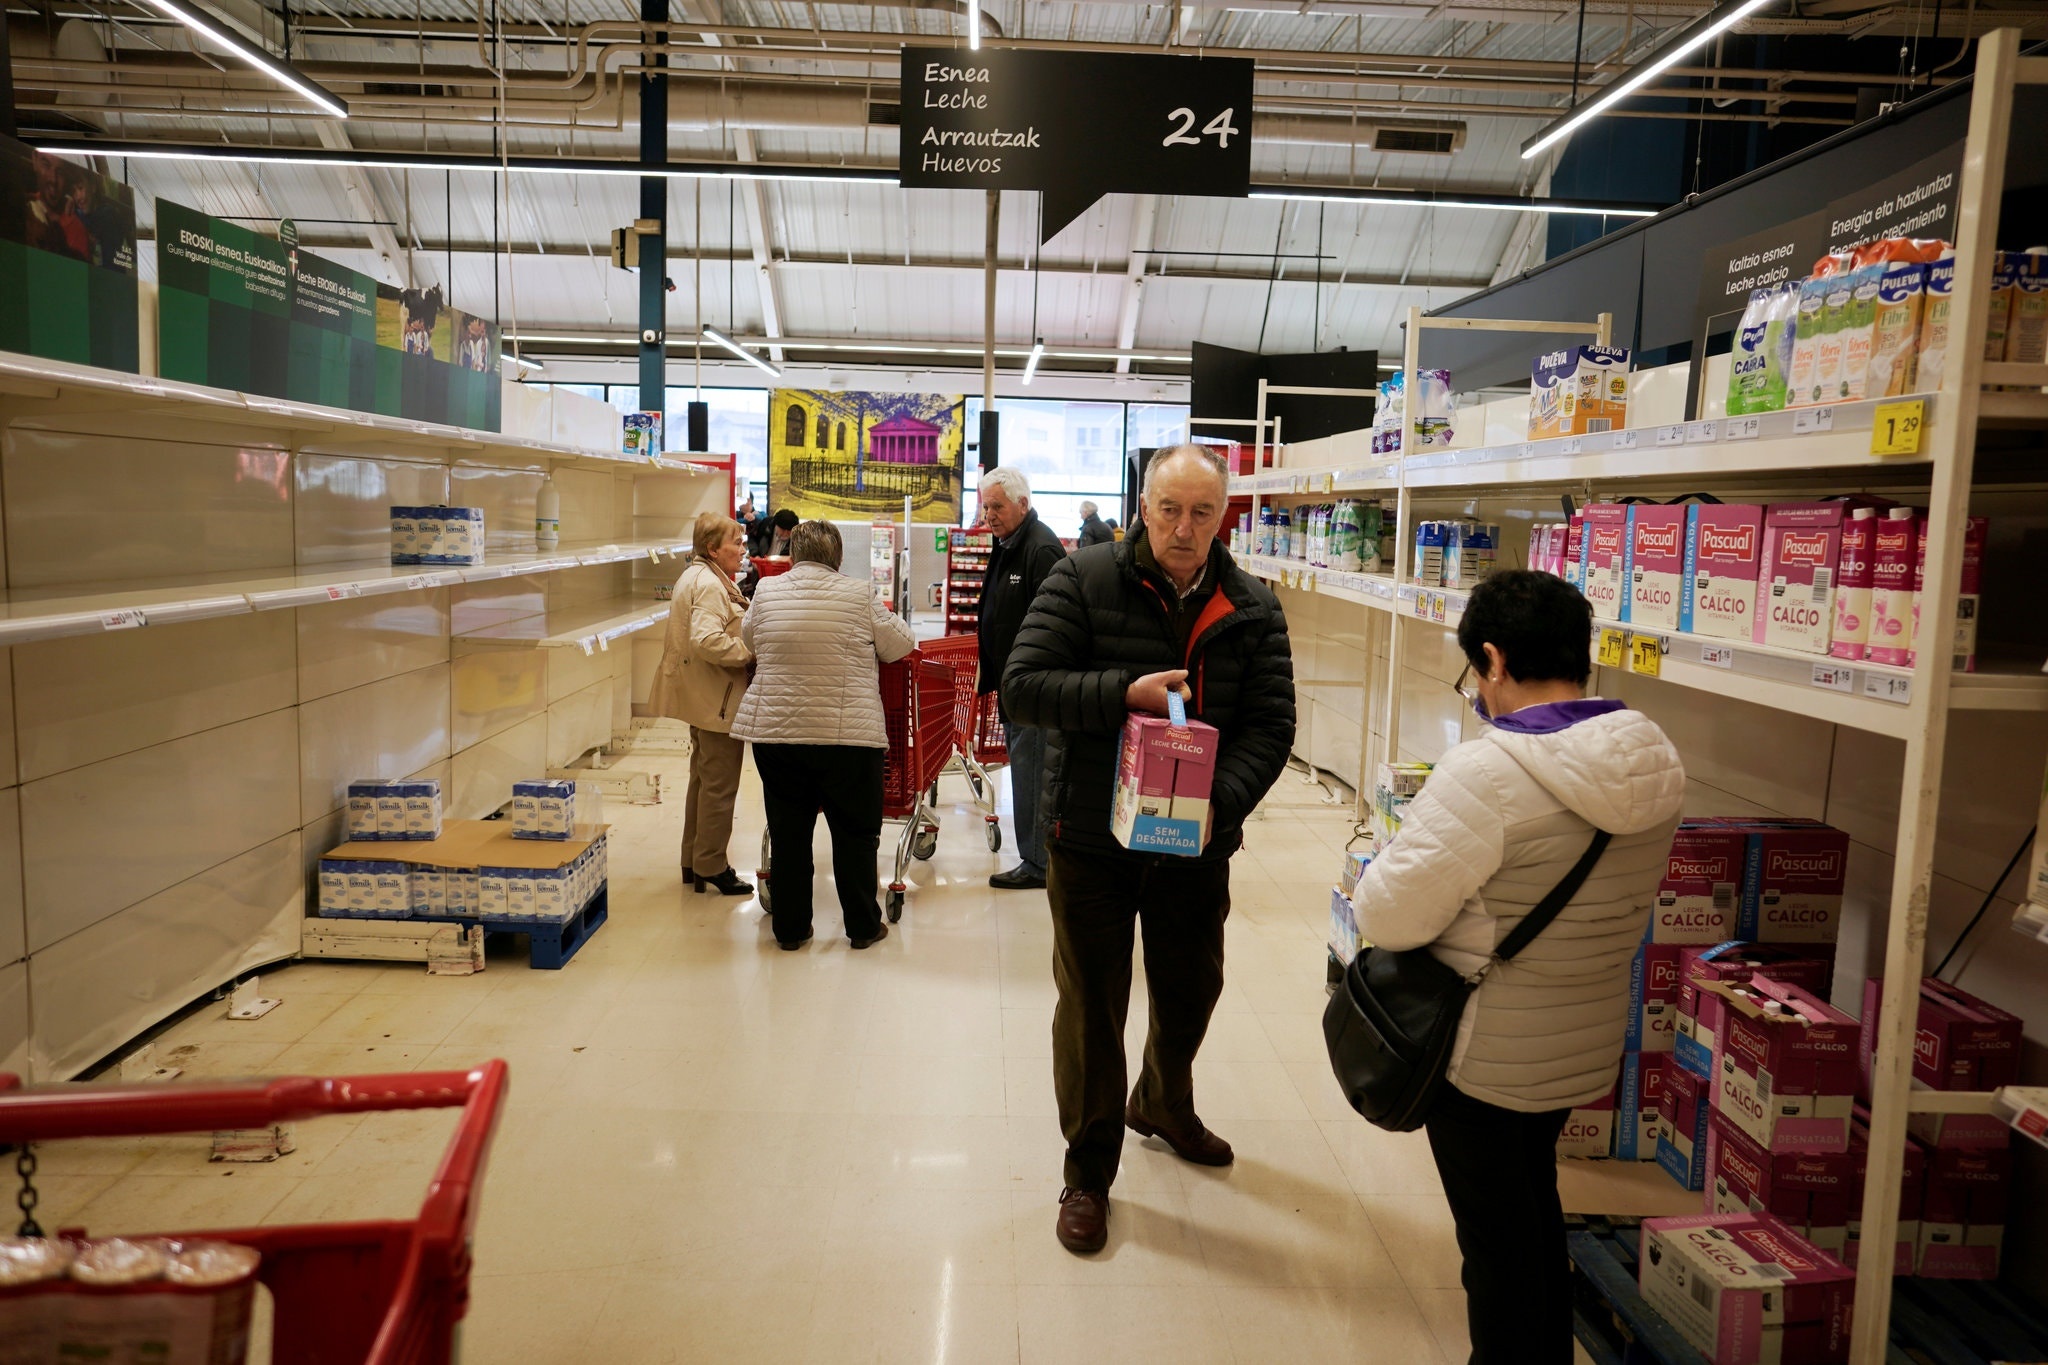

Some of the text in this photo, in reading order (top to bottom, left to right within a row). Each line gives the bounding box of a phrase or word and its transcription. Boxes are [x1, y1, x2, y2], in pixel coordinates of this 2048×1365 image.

[925, 62, 990, 83] Esnea
[924, 88, 988, 109] Leche
[921, 126, 1041, 148] Arrautzak
[1163, 107, 1239, 149] 24
[922, 152, 1002, 174] Huevos
[1831, 171, 1953, 237] Energia eta hazkuntza
[1881, 202, 1947, 241] crecimiento
[167, 243, 184, 257] Gure
[185, 245, 210, 264] ingurua
[180, 229, 287, 277] EROSKI esnea, Euskadikoa
[1728, 242, 1795, 275] Kaltzio esnea
[1725, 264, 1790, 296] Leche calcio
[1881, 271, 1921, 291] PULEVA
[1931, 266, 1954, 282] PUL
[297, 269, 367, 304] Leche EROSKI de Euskadi
[1539, 351, 1568, 370] PULEVA
[1588, 344, 1623, 357] PULEVA
[1595, 534, 1618, 547] Pascual
[1638, 530, 1676, 547] Pascual
[1703, 532, 1751, 551] Pascual
[1784, 539, 1824, 556] Pascual
[1622, 520, 1635, 606] SEMIDESNATADA
[1683, 521, 1697, 614] SEMIDESNATADA
[1587, 584, 1615, 601] CALCIO
[1636, 588, 1671, 605] CALCIO
[1756, 550, 1771, 622] DESNATADA
[1700, 595, 1746, 614] CALCIO
[1773, 606, 1820, 627] CALCIO
[1167, 730, 1191, 741] Pascual
[1151, 739, 1204, 754] LECHE CALCIO
[1136, 833, 1196, 848] DESNATADA
[1155, 826, 1180, 837] SEMI
[1670, 861, 1722, 876] Pascual
[1772, 855, 1834, 872] Pascual
[1742, 847, 1760, 929] SEMIDESNATADA
[1661, 913, 1723, 927] CALCIO
[1683, 906, 1703, 914] LECHE
[1767, 909, 1829, 923] CALCIO
[1626, 958, 1643, 1038] SEMIDESNATADA
[1731, 1026, 1767, 1056] Pascual
[1792, 1042, 1848, 1051] LECHE CALCIO
[1979, 1040, 2012, 1050] CALCIO
[1622, 1066, 1637, 1145] SEMIDESNATADA
[1724, 1081, 1763, 1119] CALCIO
[1561, 1125, 1599, 1137] LCIO
[1777, 1135, 1841, 1145] DESNATADA
[1693, 1104, 1709, 1187] SEMIDESNATADA
[1724, 1151, 1758, 1186] Pascual
[1964, 1172, 2000, 1182] CALCIO
[1804, 1175, 1839, 1184] CALCIO
[1688, 1233, 1747, 1276] CALCIO
[1750, 1231, 1806, 1269] Pascual
[1731, 1295, 1745, 1362] DESNATADA
[1829, 1314, 1842, 1351] CALCIO
